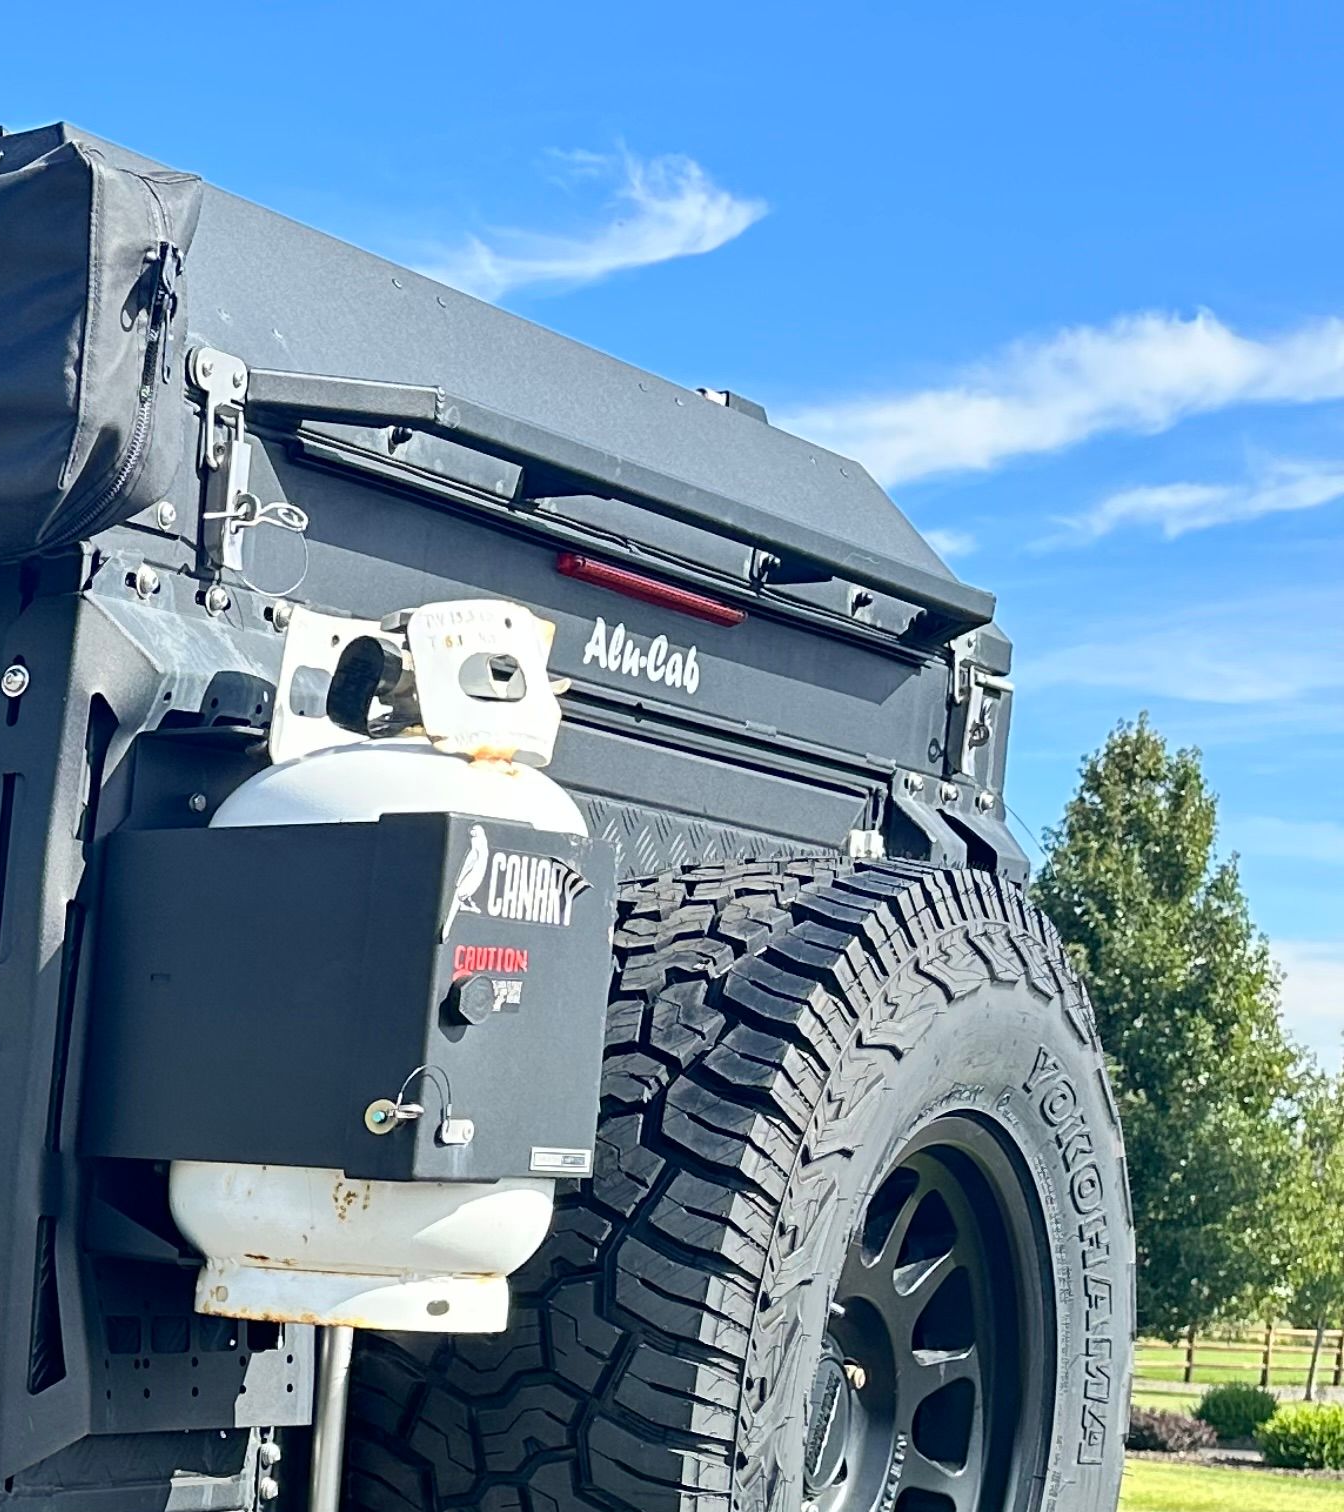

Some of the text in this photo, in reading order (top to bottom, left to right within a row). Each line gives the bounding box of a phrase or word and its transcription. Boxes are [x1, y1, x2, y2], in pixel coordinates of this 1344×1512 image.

[582, 616, 701, 694] Alu-Cab
[487, 851, 592, 927] CANARY
[454, 944, 528, 973] CAUTION
[1020, 1043, 1113, 1467] YOKOHAMA
